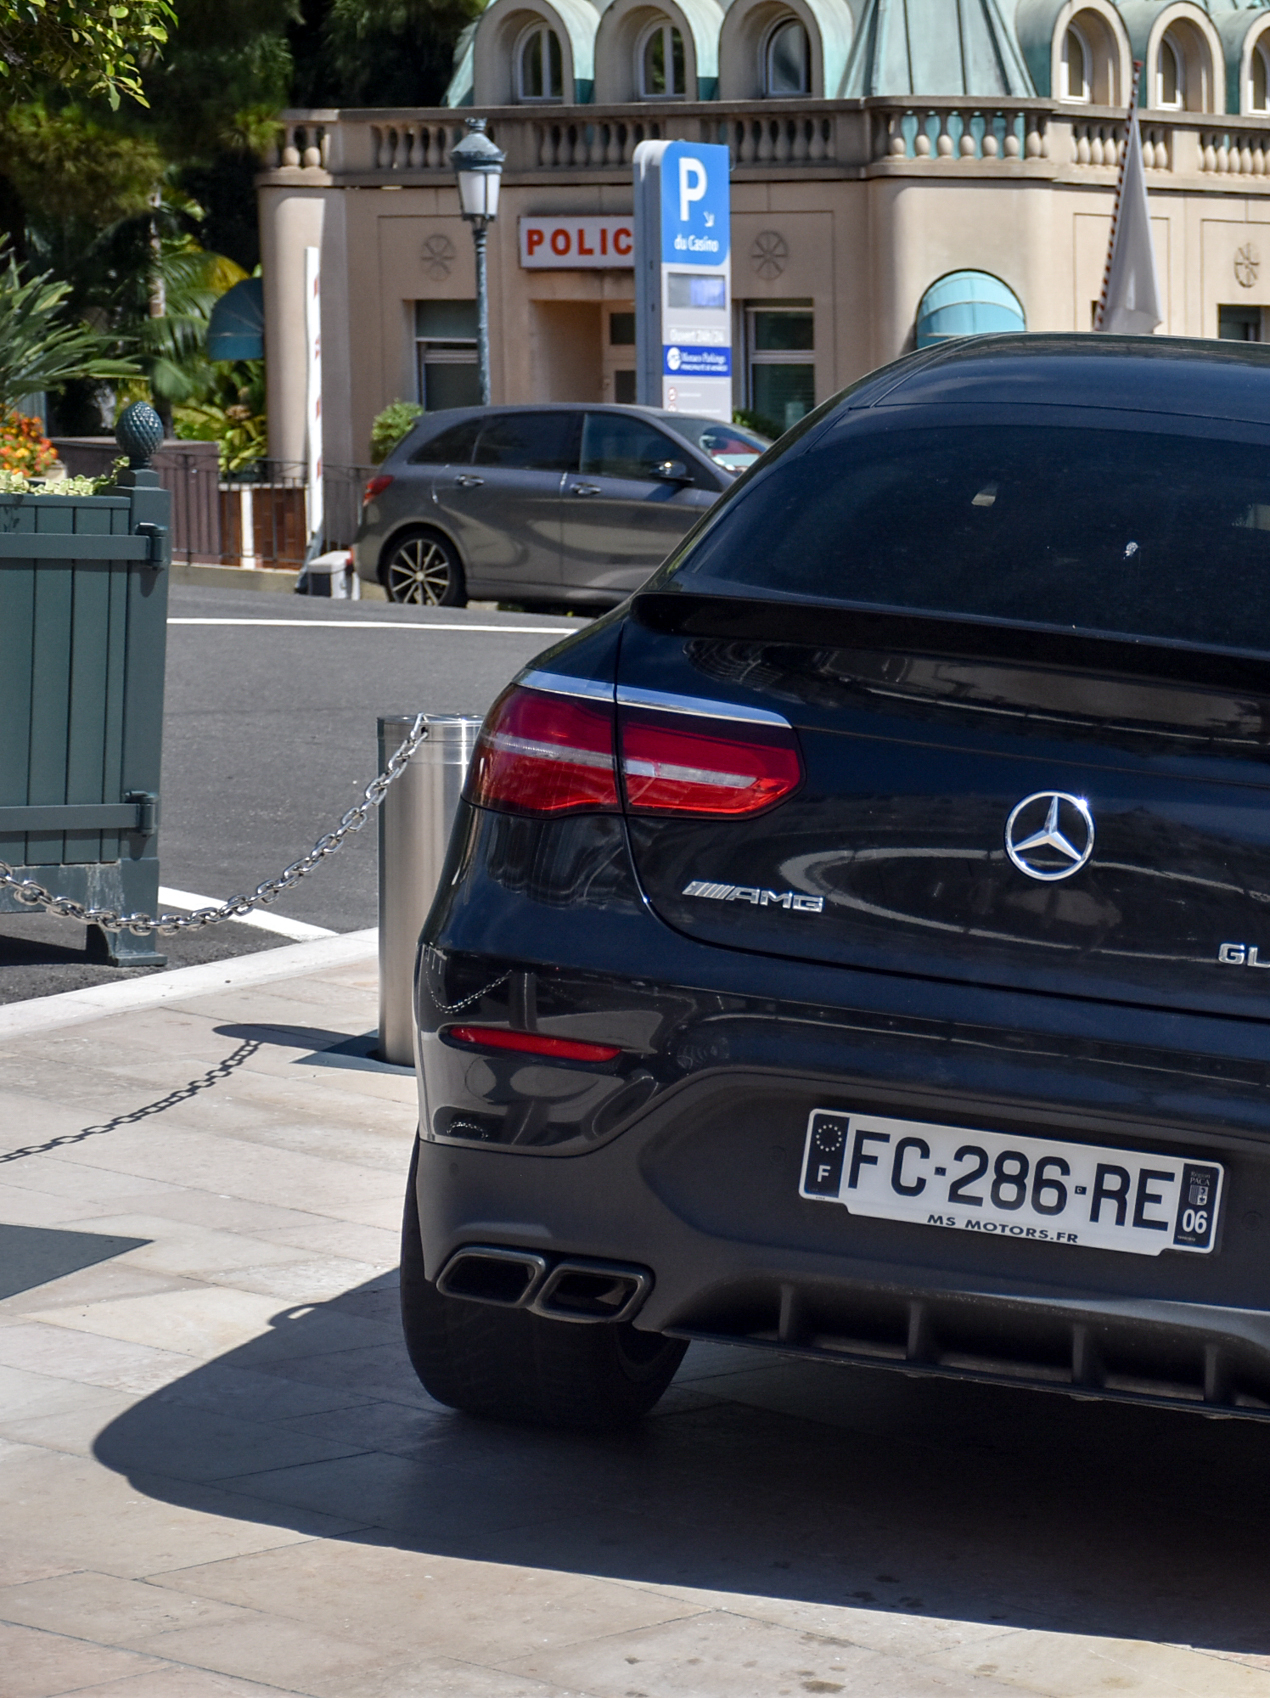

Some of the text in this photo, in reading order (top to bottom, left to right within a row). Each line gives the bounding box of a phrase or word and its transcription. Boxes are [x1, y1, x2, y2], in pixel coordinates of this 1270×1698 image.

[679, 156, 708, 221] P
[526, 227, 633, 256] POLIC
[674, 233, 719, 253] du Casino
[725, 886, 824, 913] AMG
[817, 1165, 831, 1182] F
[848, 1129, 1175, 1232] FC-286-RE
[927, 1214, 1079, 1244] MS MOTORS.FR
[1182, 1208, 1208, 1234] 06
